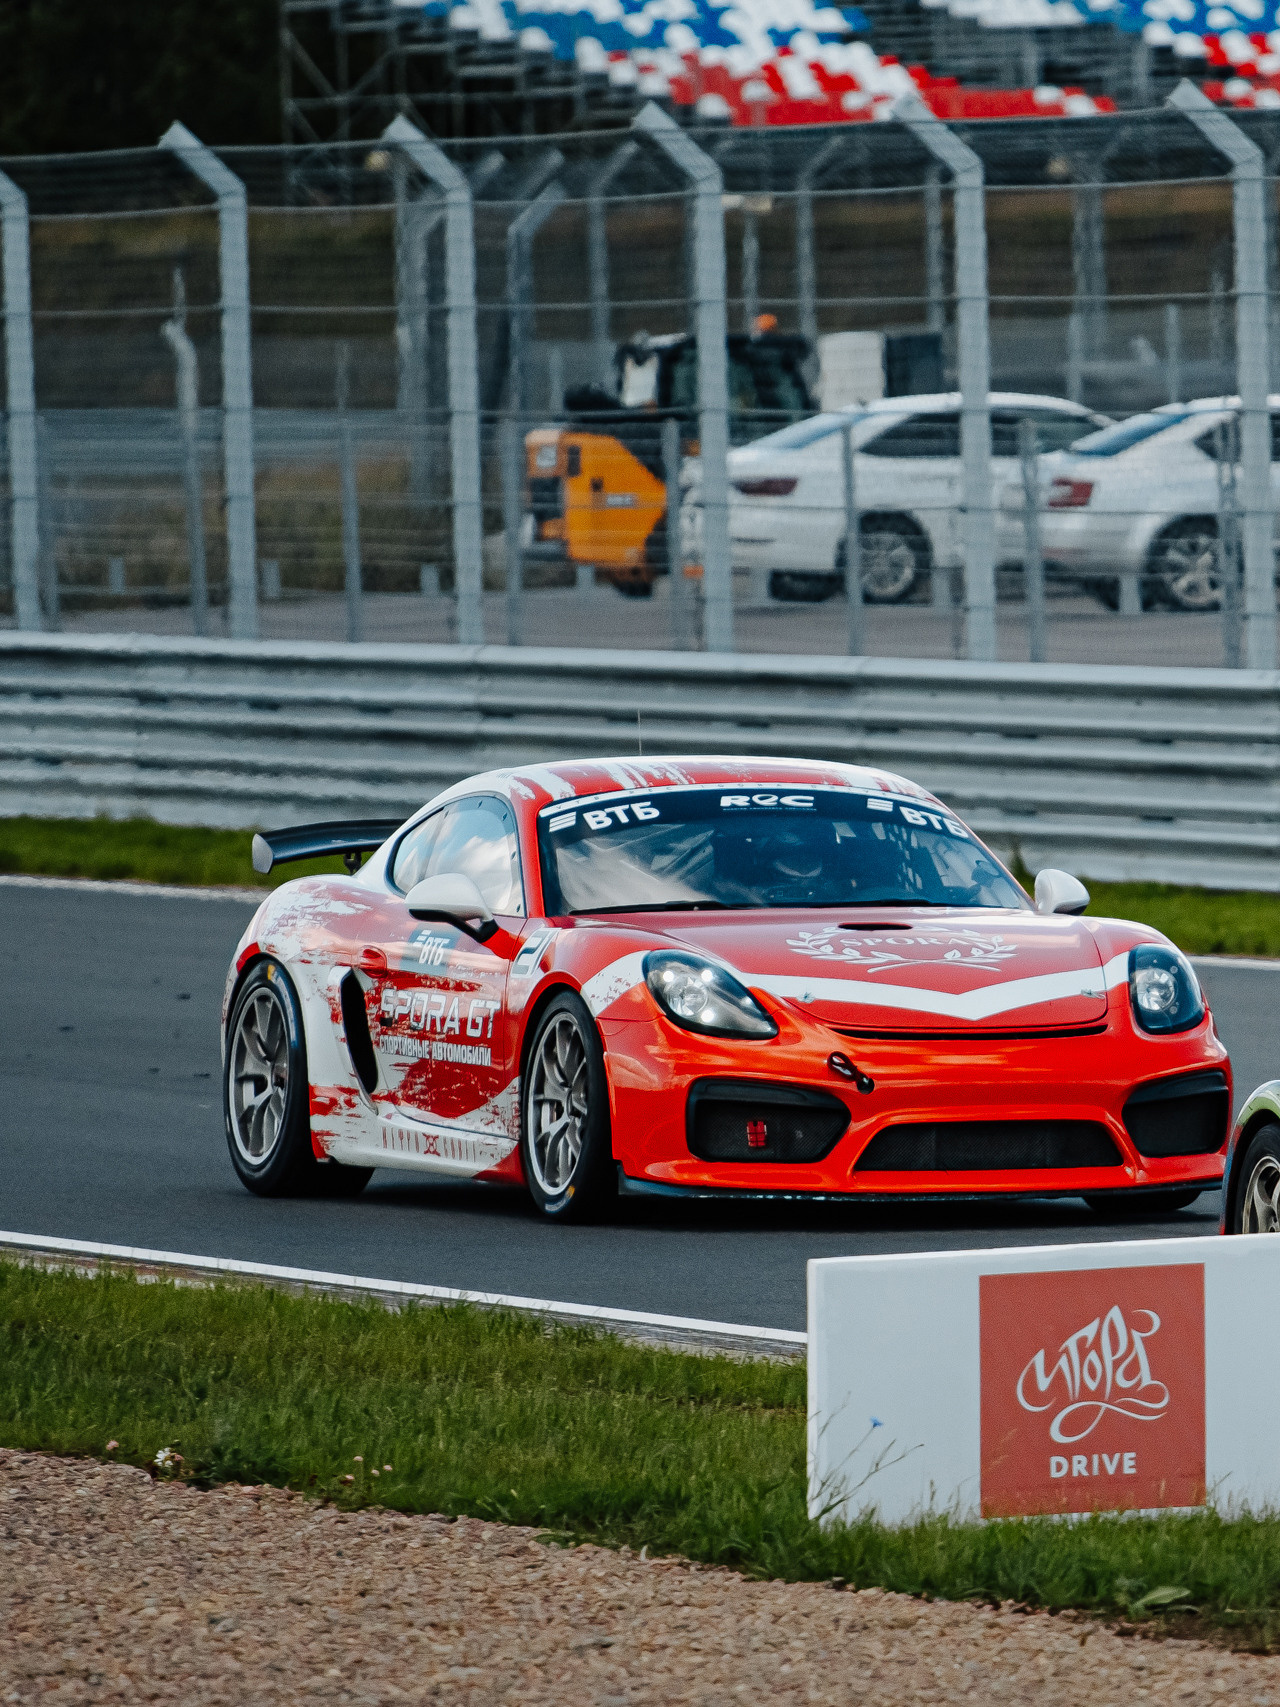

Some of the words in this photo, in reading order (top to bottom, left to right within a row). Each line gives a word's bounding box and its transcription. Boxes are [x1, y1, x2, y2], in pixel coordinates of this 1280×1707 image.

[583, 801, 660, 830] ВТБ
[900, 806, 969, 838] ВТБ
[419, 936, 451, 966] ВТБ
[840, 936, 969, 946] SPORA
[381, 988, 459, 1035] SPORA
[466, 998, 501, 1039] GT
[380, 1034, 430, 1060] СПОРТИВНЫЕ
[431, 1040, 492, 1067] АВТОМОБИЛИ
[1050, 1452, 1137, 1478] DRIVE
